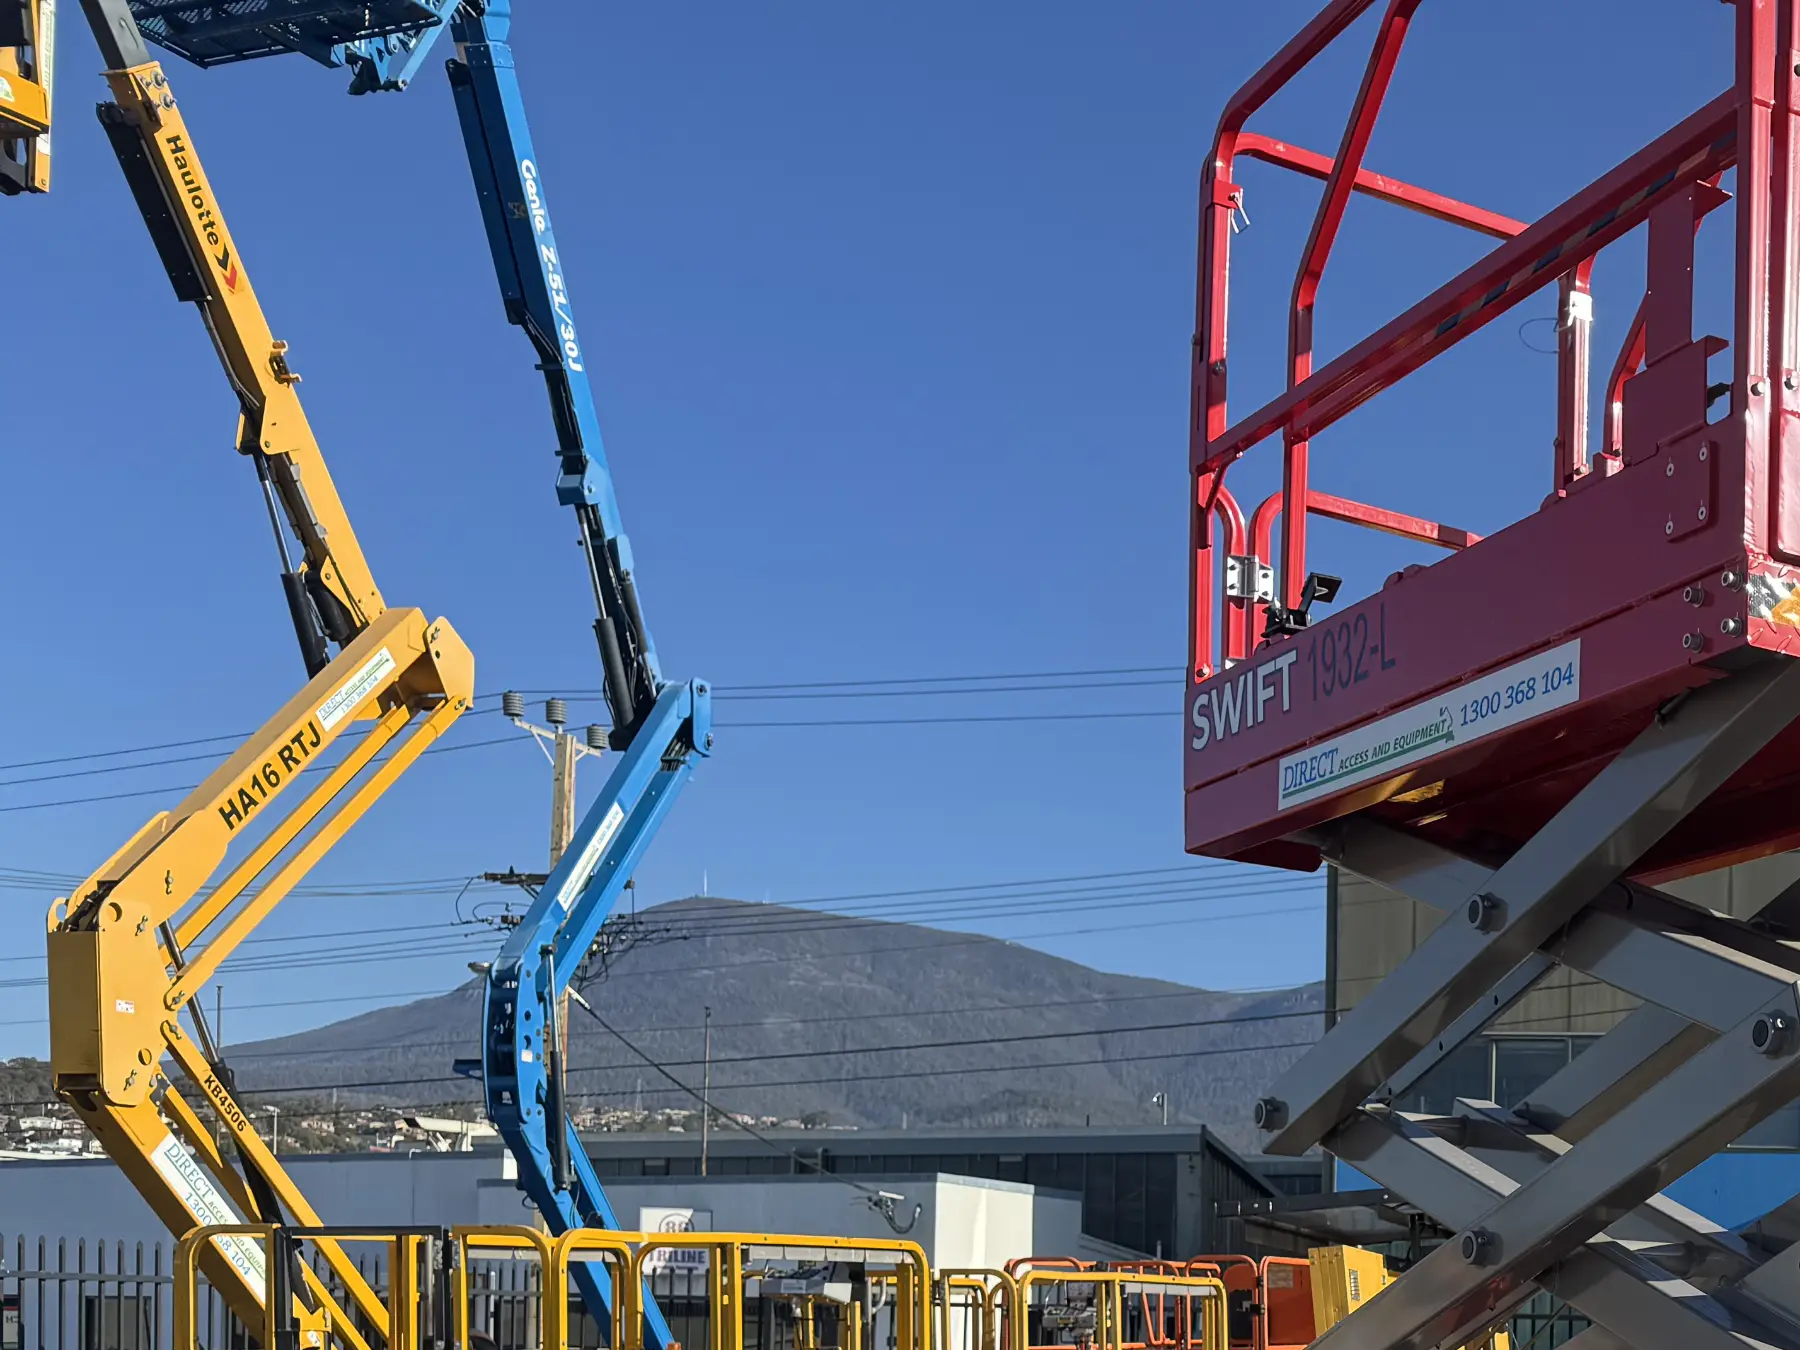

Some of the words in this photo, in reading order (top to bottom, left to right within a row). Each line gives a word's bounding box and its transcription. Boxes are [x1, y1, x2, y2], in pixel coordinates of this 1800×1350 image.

[166, 134, 219, 246] Haulotte
[521, 158, 545, 236] Genie
[1192, 649, 1297, 750] SWIFT
[1307, 603, 1395, 701] 1932-L
[1283, 747, 1339, 792] DIRECT
[1338, 749, 1369, 773] ACCESS
[1371, 741, 1391, 758] AND
[1393, 718, 1447, 751] EQUIPMENT
[1460, 691, 1501, 727] 1300
[1504, 676, 1537, 709] 368
[1541, 661, 1574, 696] 104
[218, 762, 281, 831] HA16
[277, 720, 321, 773] RTJ
[203, 1074, 247, 1132] KB4506
[166, 1143, 215, 1199] DIRECT
[231, 1251, 251, 1276] 104
